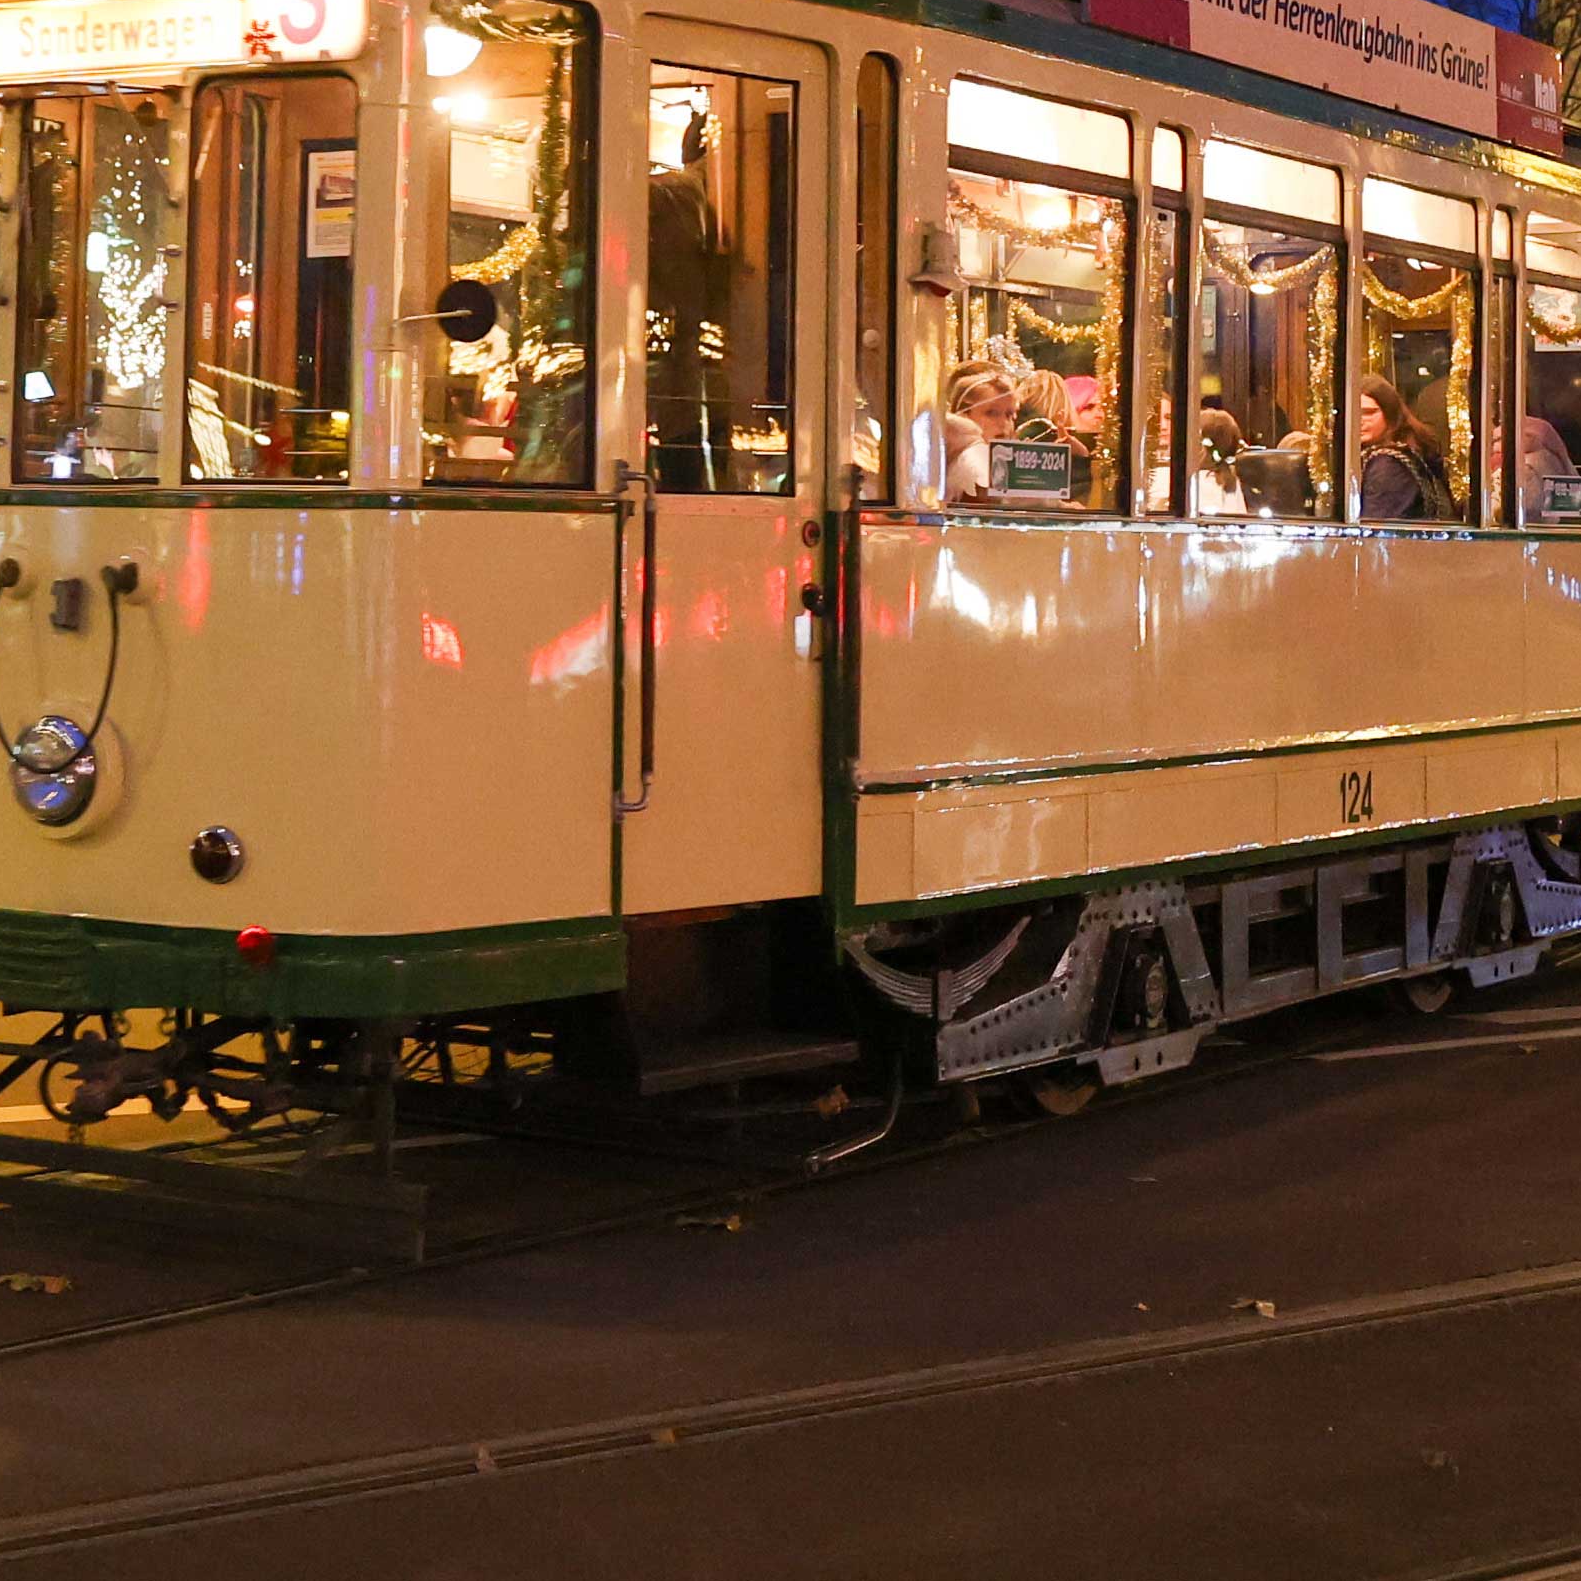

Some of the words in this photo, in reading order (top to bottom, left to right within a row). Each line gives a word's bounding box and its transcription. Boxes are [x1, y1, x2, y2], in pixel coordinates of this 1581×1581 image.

[19, 10, 214, 59] Sonderwagen
[1417, 31, 1438, 75] ins
[1441, 42, 1490, 92] Grüne!
[1013, 450, 1066, 471] 1899-2024
[1340, 770, 1374, 824] 124
